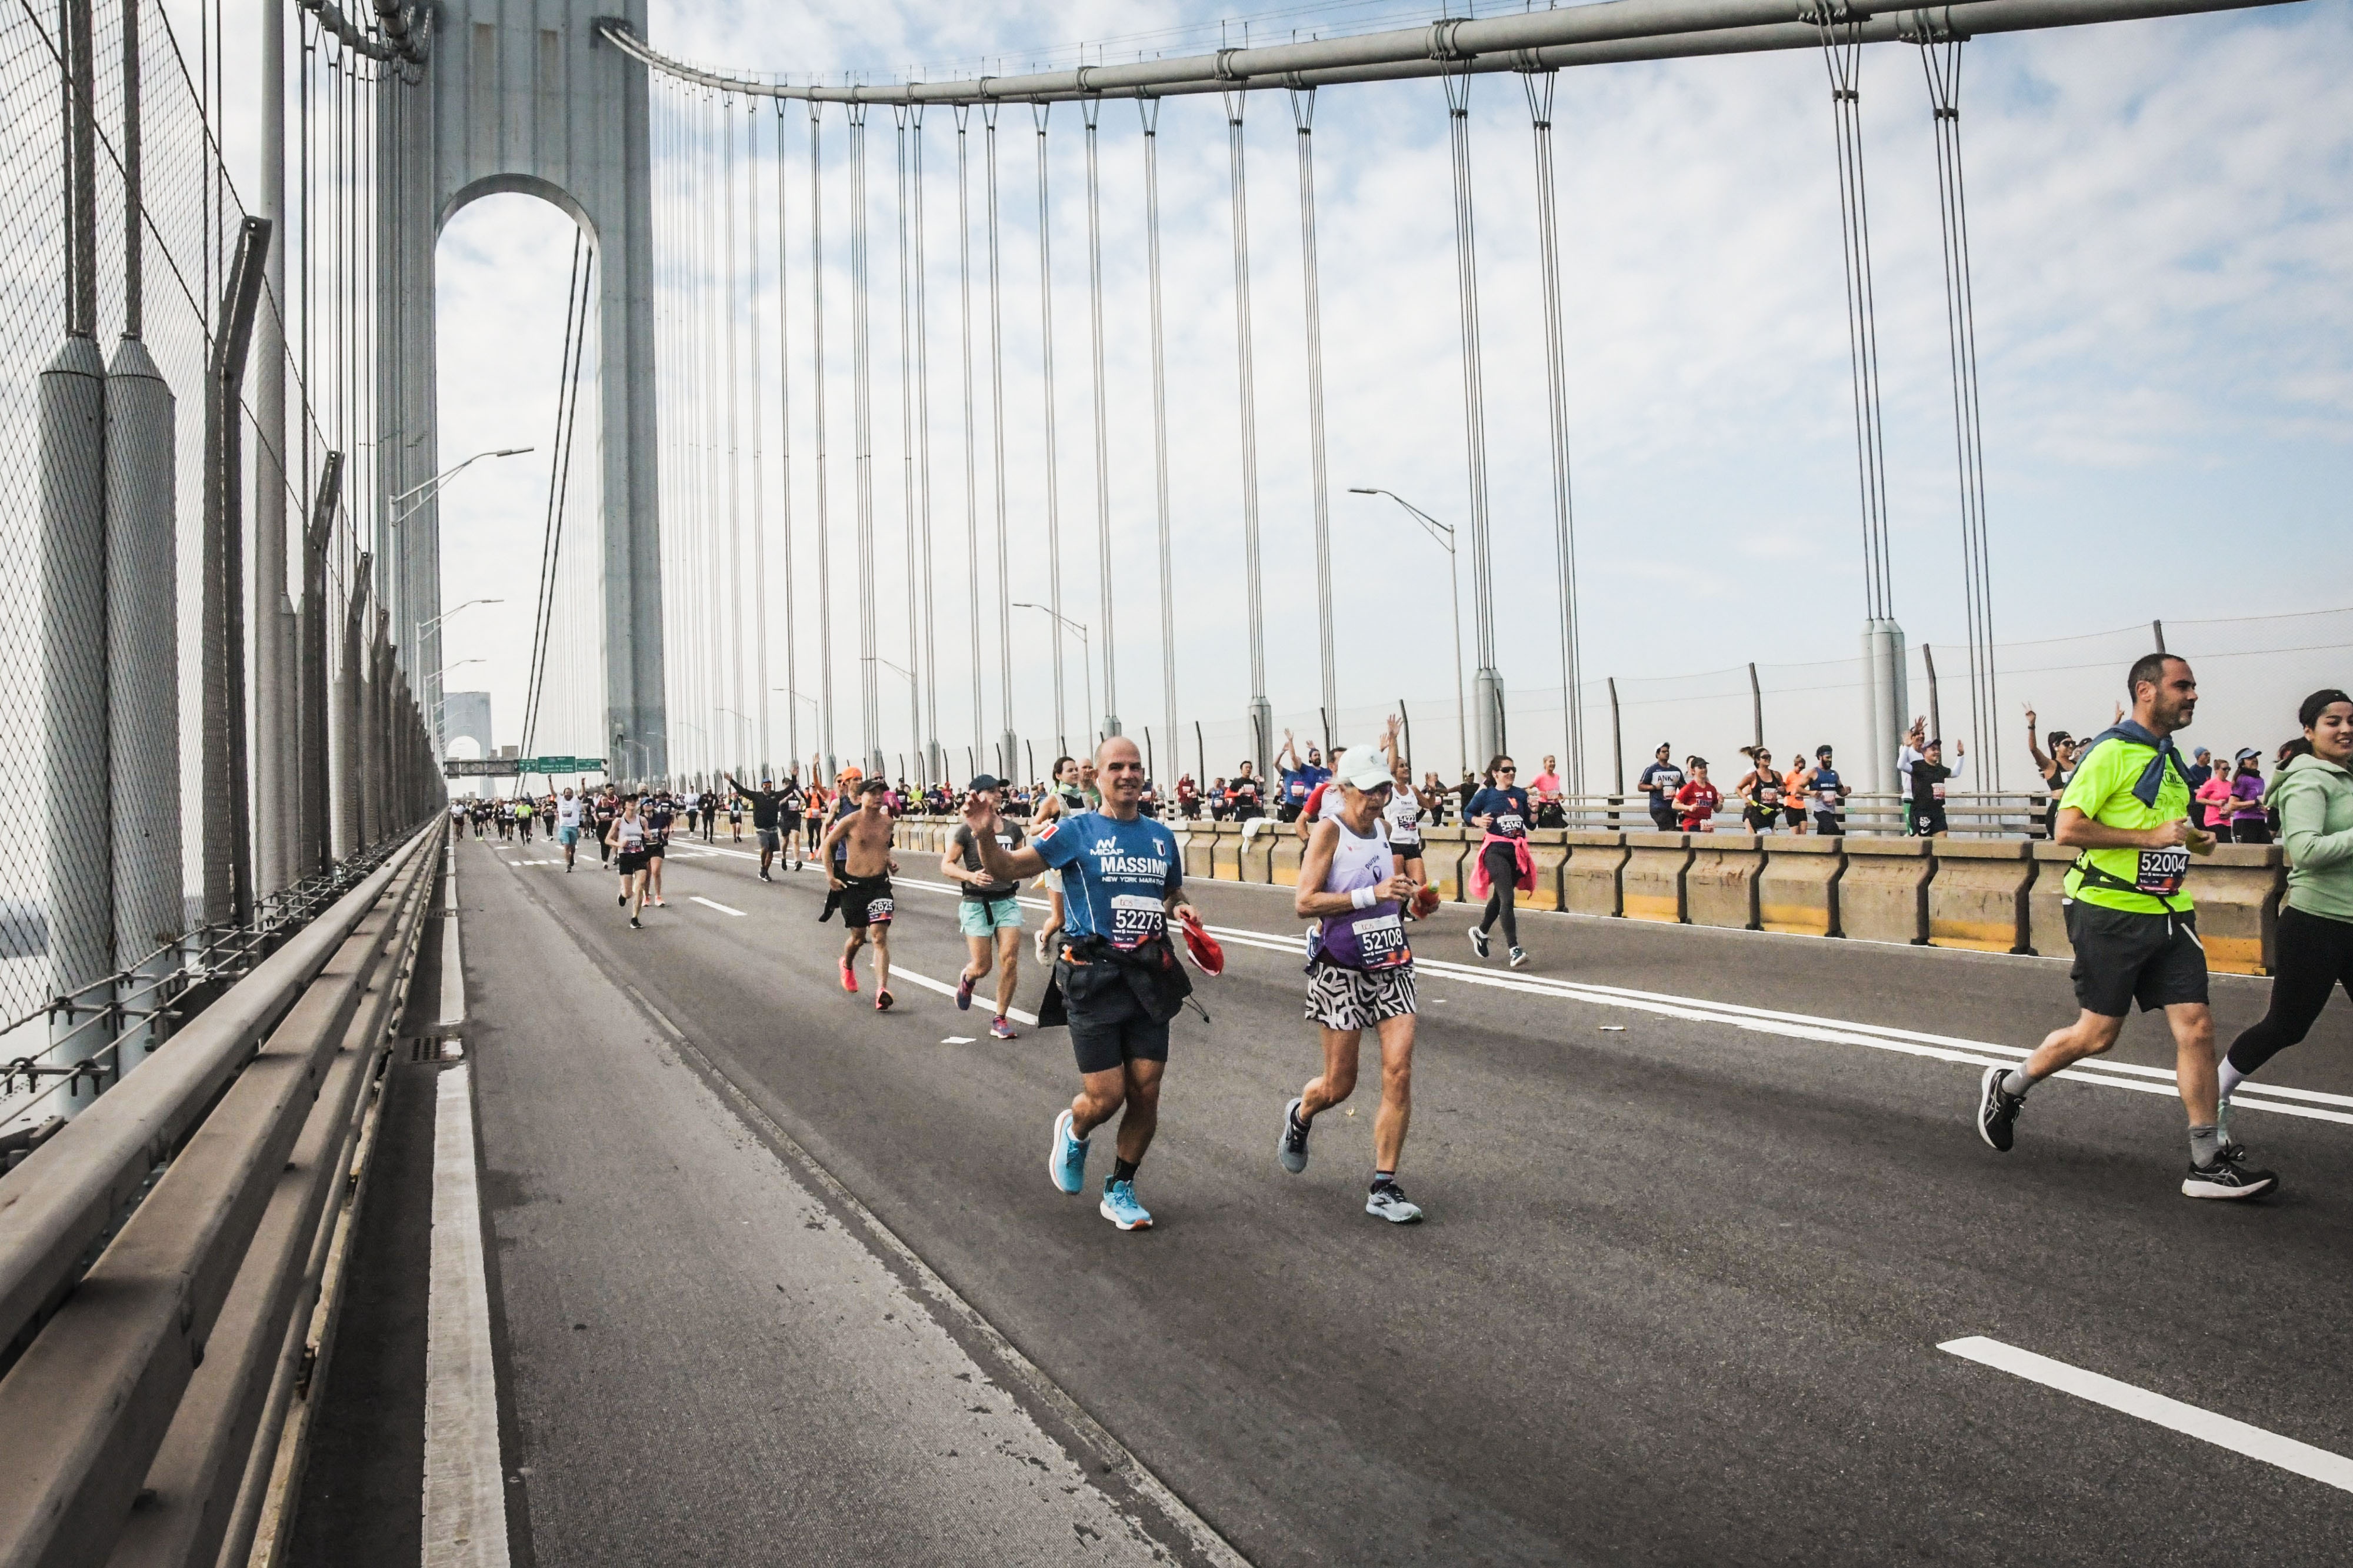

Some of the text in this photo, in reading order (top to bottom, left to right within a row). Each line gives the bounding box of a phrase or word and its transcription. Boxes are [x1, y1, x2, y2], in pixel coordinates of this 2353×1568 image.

[1501, 821, 1522, 830] 54147
[1101, 856, 1168, 877] MASSIMO
[1365, 854, 1381, 870] purple
[2141, 853, 2187, 872] 52004
[868, 902, 893, 912] 52625
[1120, 898, 1133, 906] tcs
[1115, 909, 1162, 930] 52273
[1362, 928, 1403, 951] 52108
